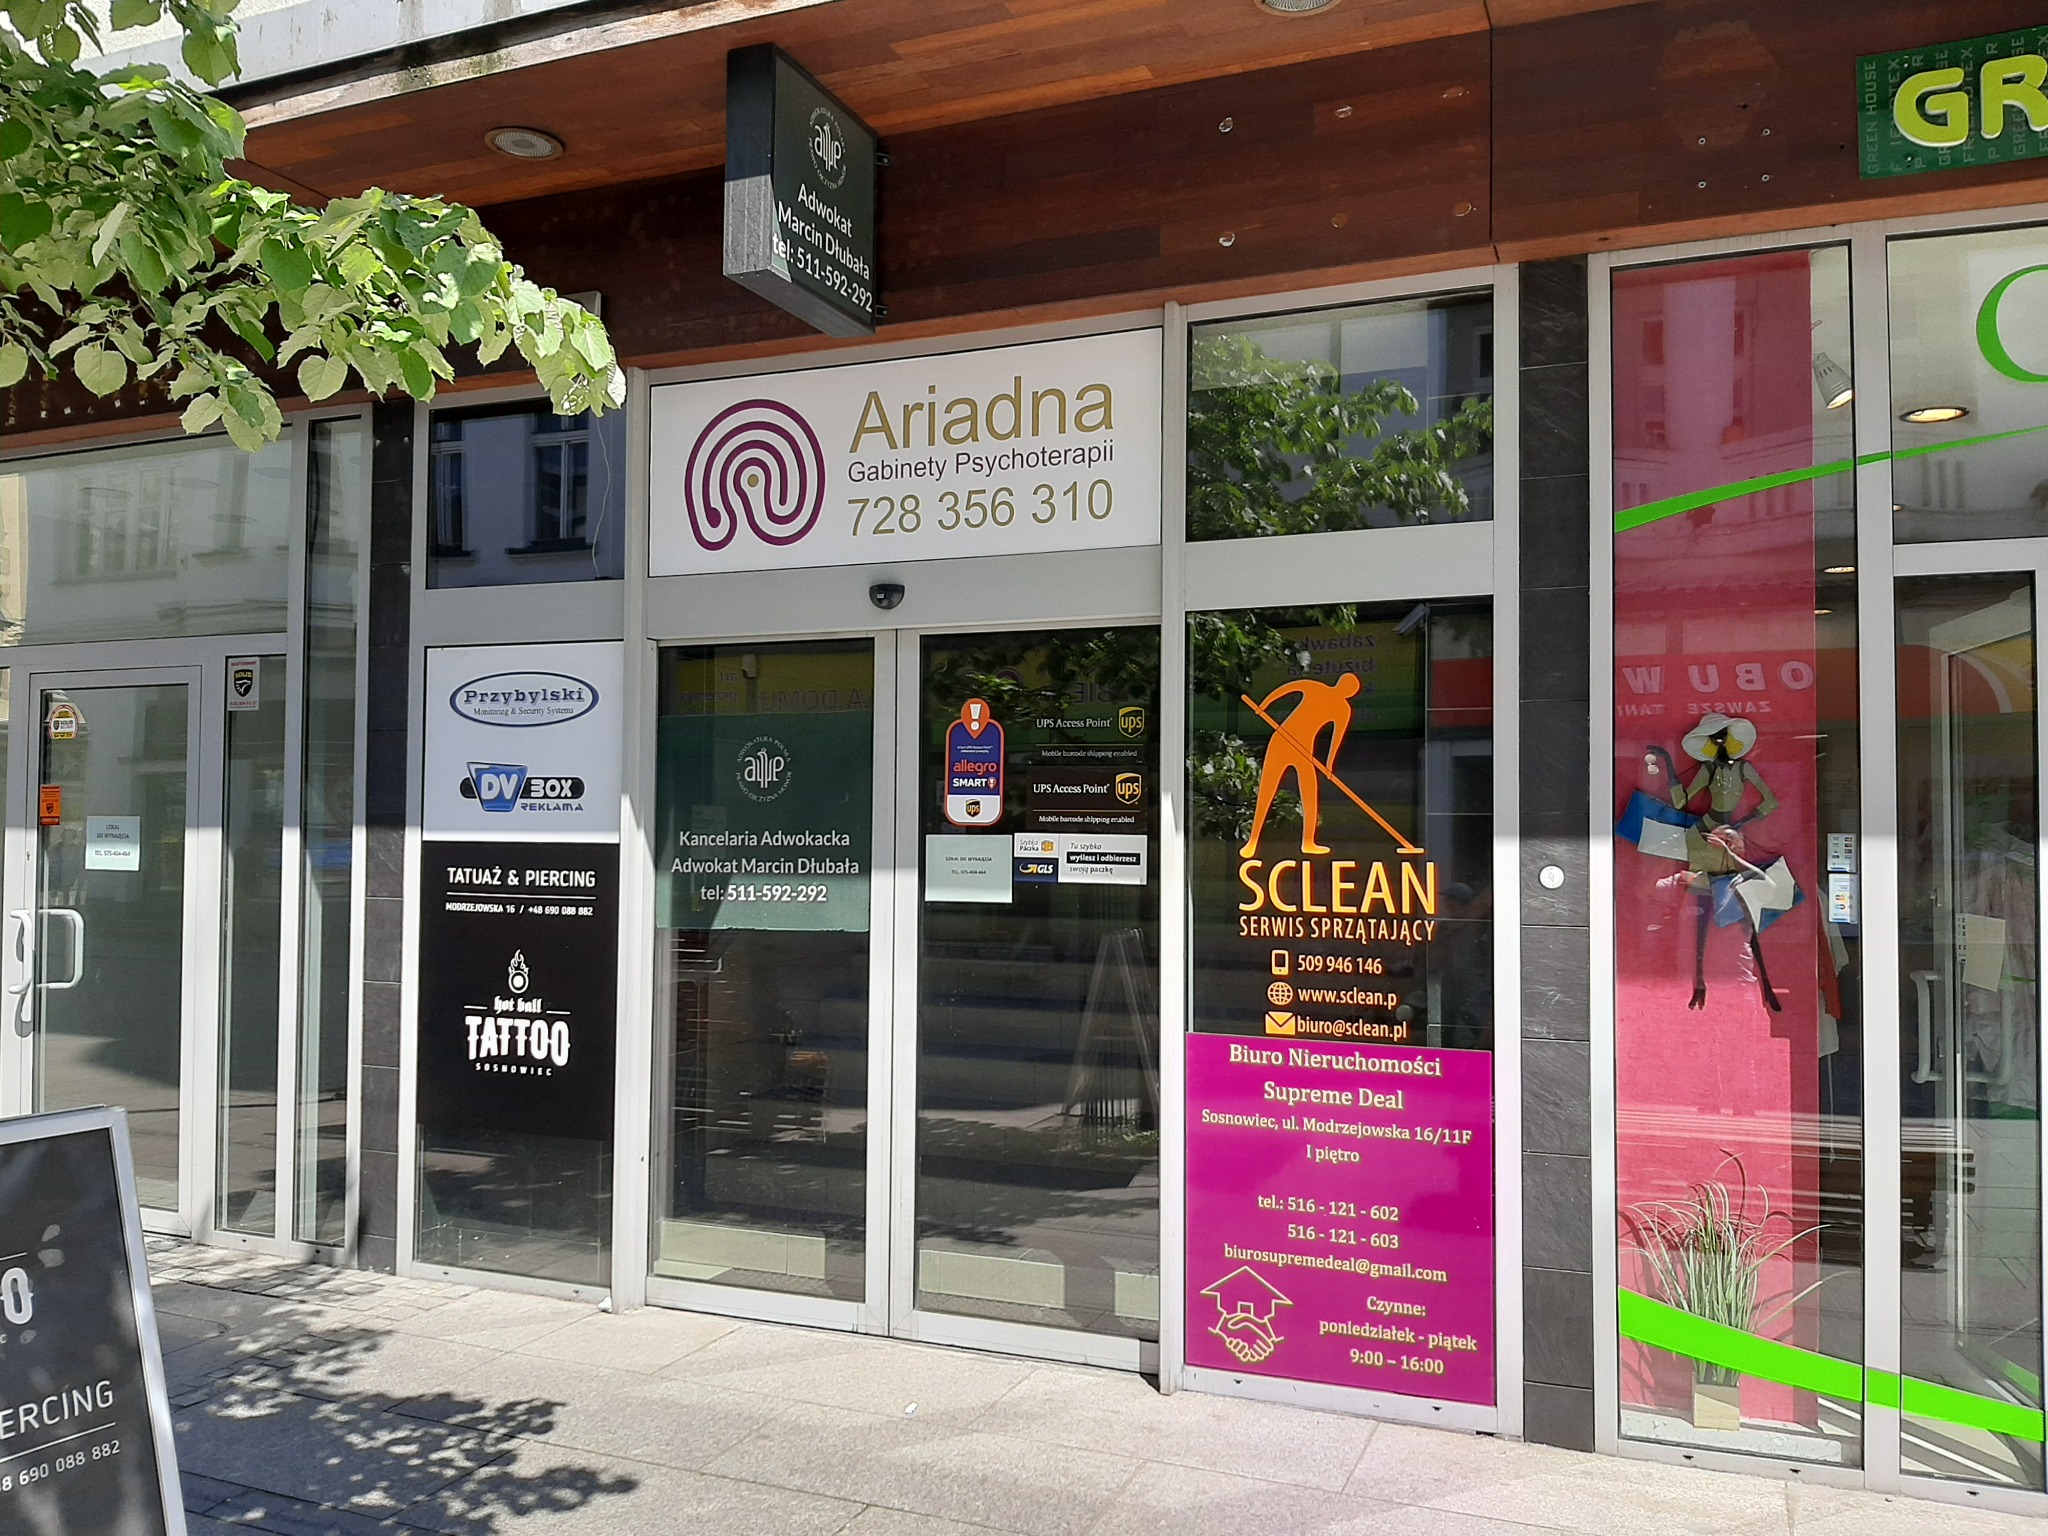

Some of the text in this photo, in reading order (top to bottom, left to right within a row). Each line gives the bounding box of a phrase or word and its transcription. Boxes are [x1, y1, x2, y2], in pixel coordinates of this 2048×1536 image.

[1864, 60, 1880, 174] GREEN HOUSE
[798, 183, 852, 238] Adwokat
[778, 201, 870, 281] Marcin Dłubała
[772, 232, 873, 313] tel: 511-592-292
[848, 376, 1115, 454] Ariadna
[847, 439, 1115, 484] Gabinety Psychoterapii
[847, 478, 1113, 537] 728 356 310
[464, 687, 585, 705] Przybylski
[473, 706, 574, 717] Monitoring & Security Systems
[1036, 719, 1054, 728] UPS
[1055, 719, 1084, 728] Access
[1121, 717, 1142, 733] ups
[1087, 750, 1112, 758] shipping
[953, 759, 997, 775] allegro
[480, 773, 520, 800] DV
[530, 778, 574, 798] BOX
[1033, 784, 1052, 793] UPS
[1052, 784, 1082, 793] Access
[1117, 782, 1139, 799] ups
[520, 802, 584, 812] REKLAMA
[1039, 815, 1059, 823] Mobile
[1060, 815, 1084, 823] barcode
[1084, 816, 1110, 824] shipping
[680, 831, 850, 847] Kancelaria Adwokacka
[671, 858, 859, 875] Adwokat Marcin Dłubała
[1037, 864, 1054, 873] GLS
[1089, 866, 1113, 874] paczkę
[1100, 854, 1137, 863] odbierzesz
[447, 866, 596, 887] TATUAŻ & PIERCING
[1238, 859, 1435, 915] SCLEAN
[700, 885, 828, 902] tel: 511-592-292
[445, 902, 504, 913] MODRZEJOWSKA
[506, 904, 516, 914] 16
[528, 905, 543, 914] +48
[545, 905, 560, 915] 690
[561, 906, 577, 915] 088
[578, 906, 594, 916] 882
[1239, 915, 1435, 945] SERWIS SPRZĄTAJĄCY
[1298, 954, 1382, 975] 509 946 146
[1298, 982, 1397, 1007] www.sclean.p
[1297, 1014, 1407, 1039] biuro@sclean.pl
[465, 1015, 571, 1066] TATTOO
[475, 1062, 553, 1076] SOSNOWIEC
[1229, 1044, 1442, 1076] Biuro Nieruchomości
[1264, 1081, 1403, 1109] Supreme Deal
[1202, 1109, 1472, 1145] Sosnowiec, ul. Modrzejowska 16/11F
[1315, 1145, 1360, 1163] piętro
[1257, 1194, 1284, 1210] tel.:
[1287, 1197, 1316, 1213] 516
[1328, 1201, 1357, 1217] 121
[1370, 1205, 1399, 1221] 602
[1287, 1224, 1316, 1241] 516
[1328, 1228, 1357, 1245] 121
[1370, 1232, 1399, 1249] 603
[1224, 1243, 1448, 1282] biurosupremedeal@gmail.com
[1366, 1296, 1426, 1317] Czynne:
[1319, 1319, 1415, 1343] poniedziałek
[1428, 1333, 1477, 1351] piątek
[1350, 1348, 1384, 1366] 9:00
[1400, 1355, 1444, 1374] 16:00
[0, 1440, 120, 1492] 8 690 088 882
